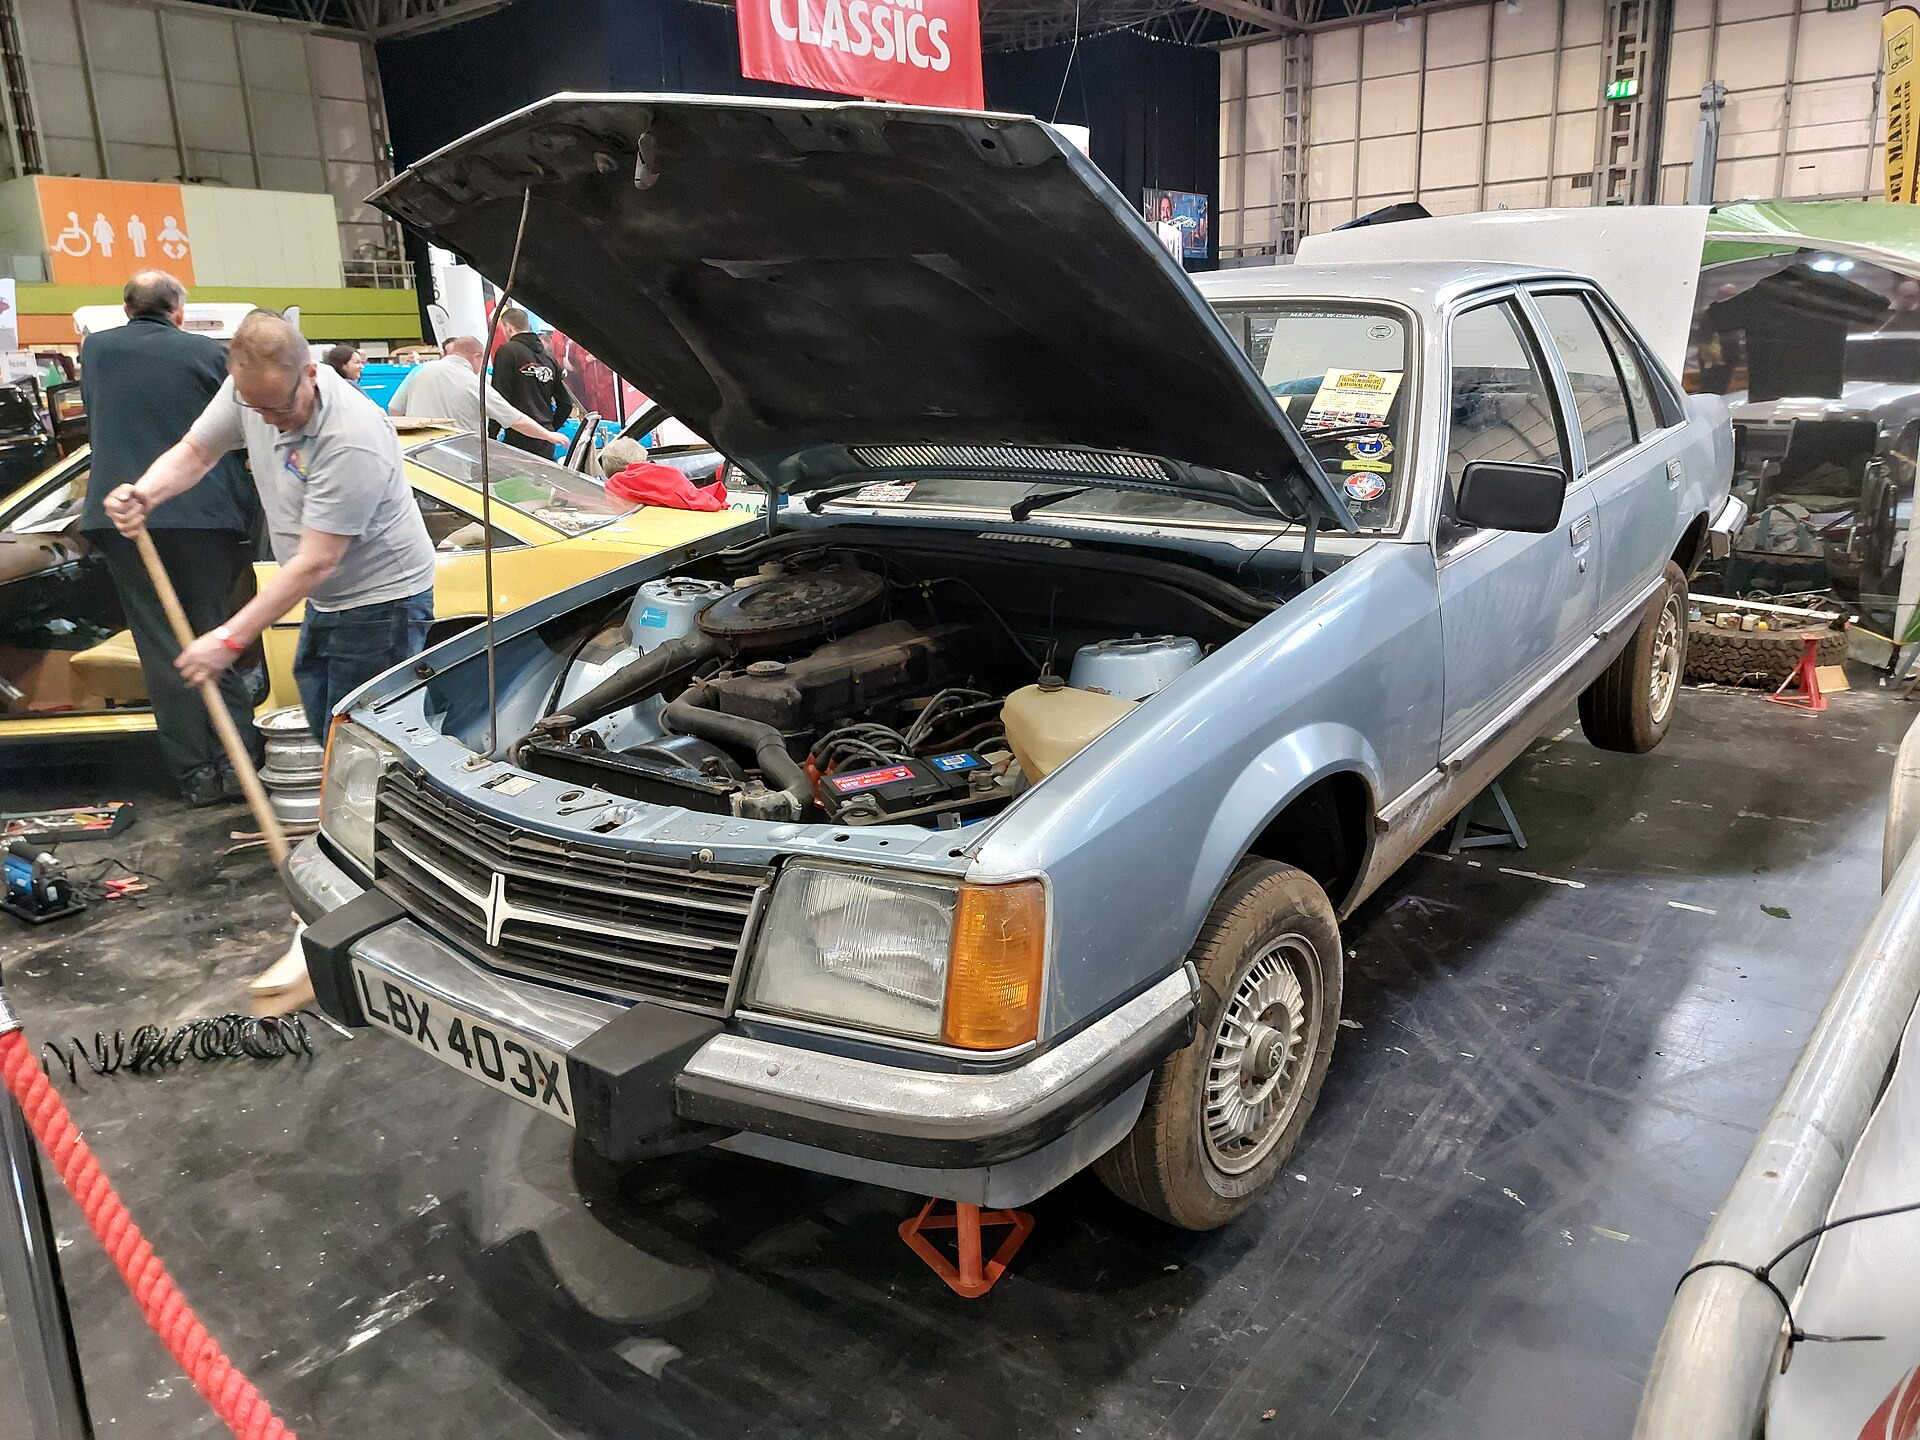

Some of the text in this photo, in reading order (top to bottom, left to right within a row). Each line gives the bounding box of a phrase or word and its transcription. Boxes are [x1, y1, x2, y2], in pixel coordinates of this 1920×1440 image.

[770, 0, 951, 72] CLASSICS
[1891, 55, 1910, 70] OPEL
[1888, 83, 1904, 164] MANTA
[358, 968, 570, 1116] LBX 403X
